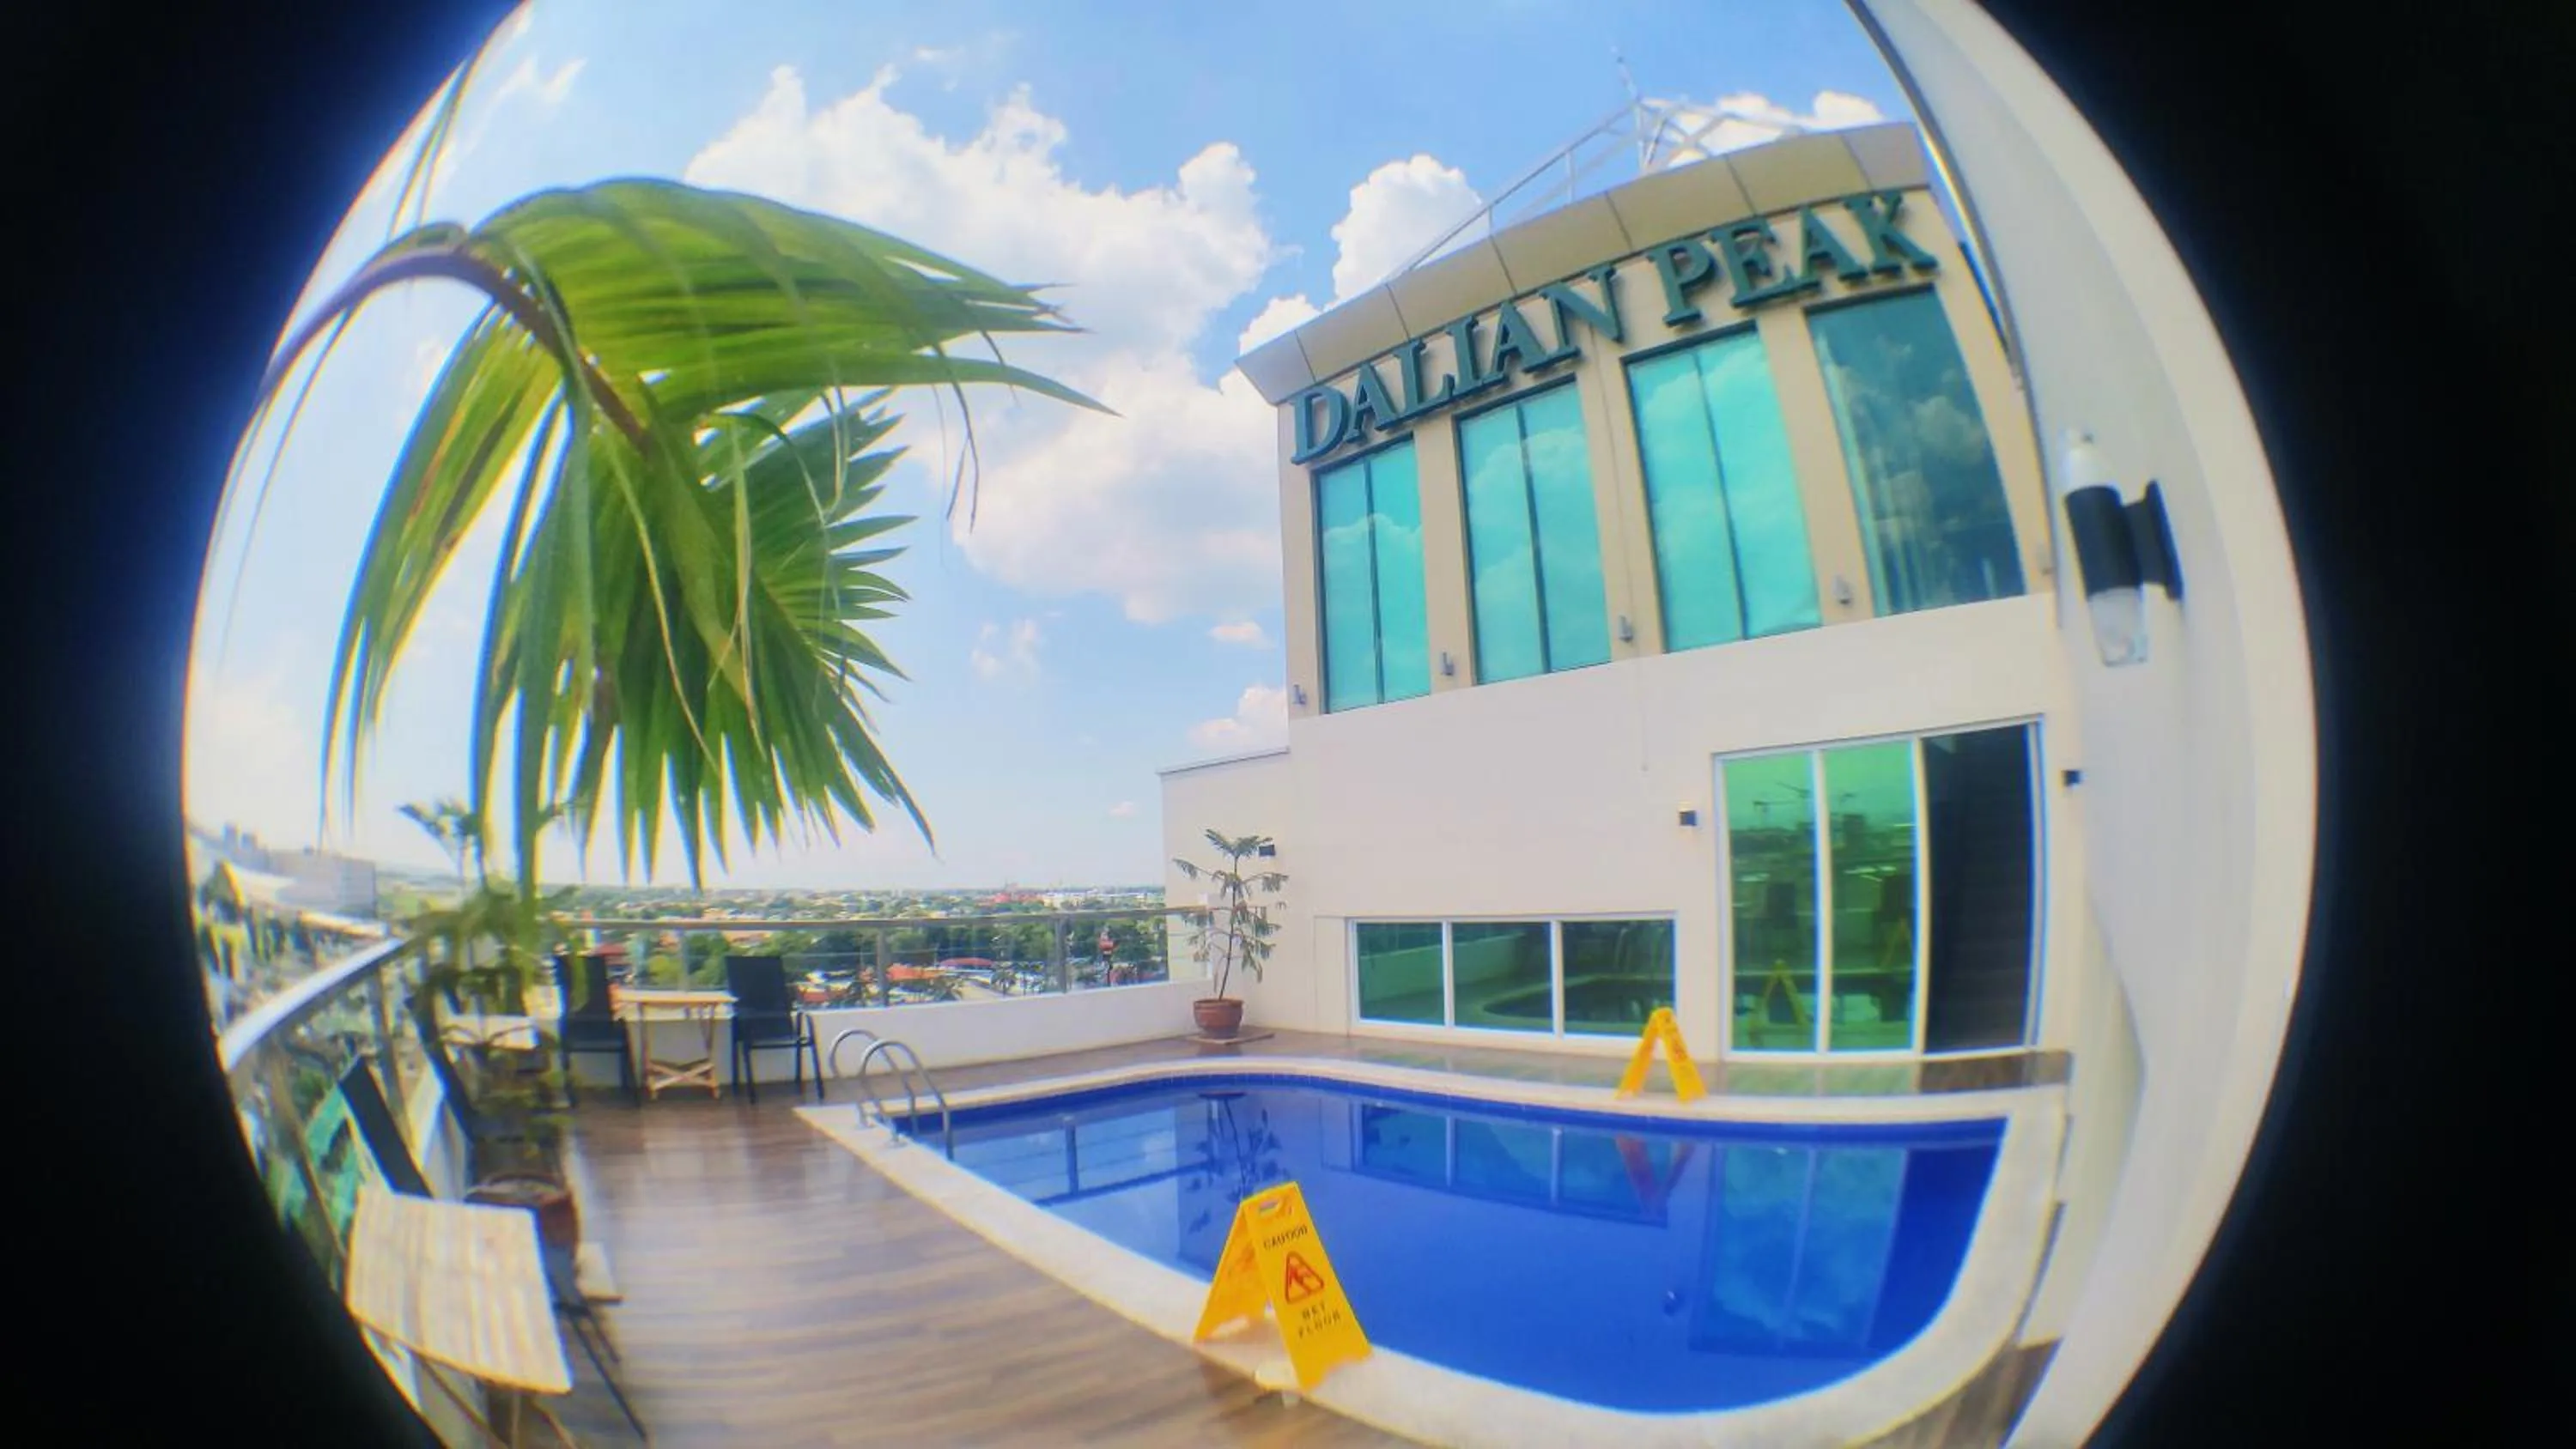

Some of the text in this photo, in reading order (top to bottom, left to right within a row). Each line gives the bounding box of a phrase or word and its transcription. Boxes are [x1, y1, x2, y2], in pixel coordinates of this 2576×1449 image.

[1291, 191, 1938, 465] DALIAN PEAK
[1263, 1223, 1308, 1250] CAUTION
[1297, 1309, 1341, 1339] FLOOR
[1302, 1301, 1327, 1320] WET
